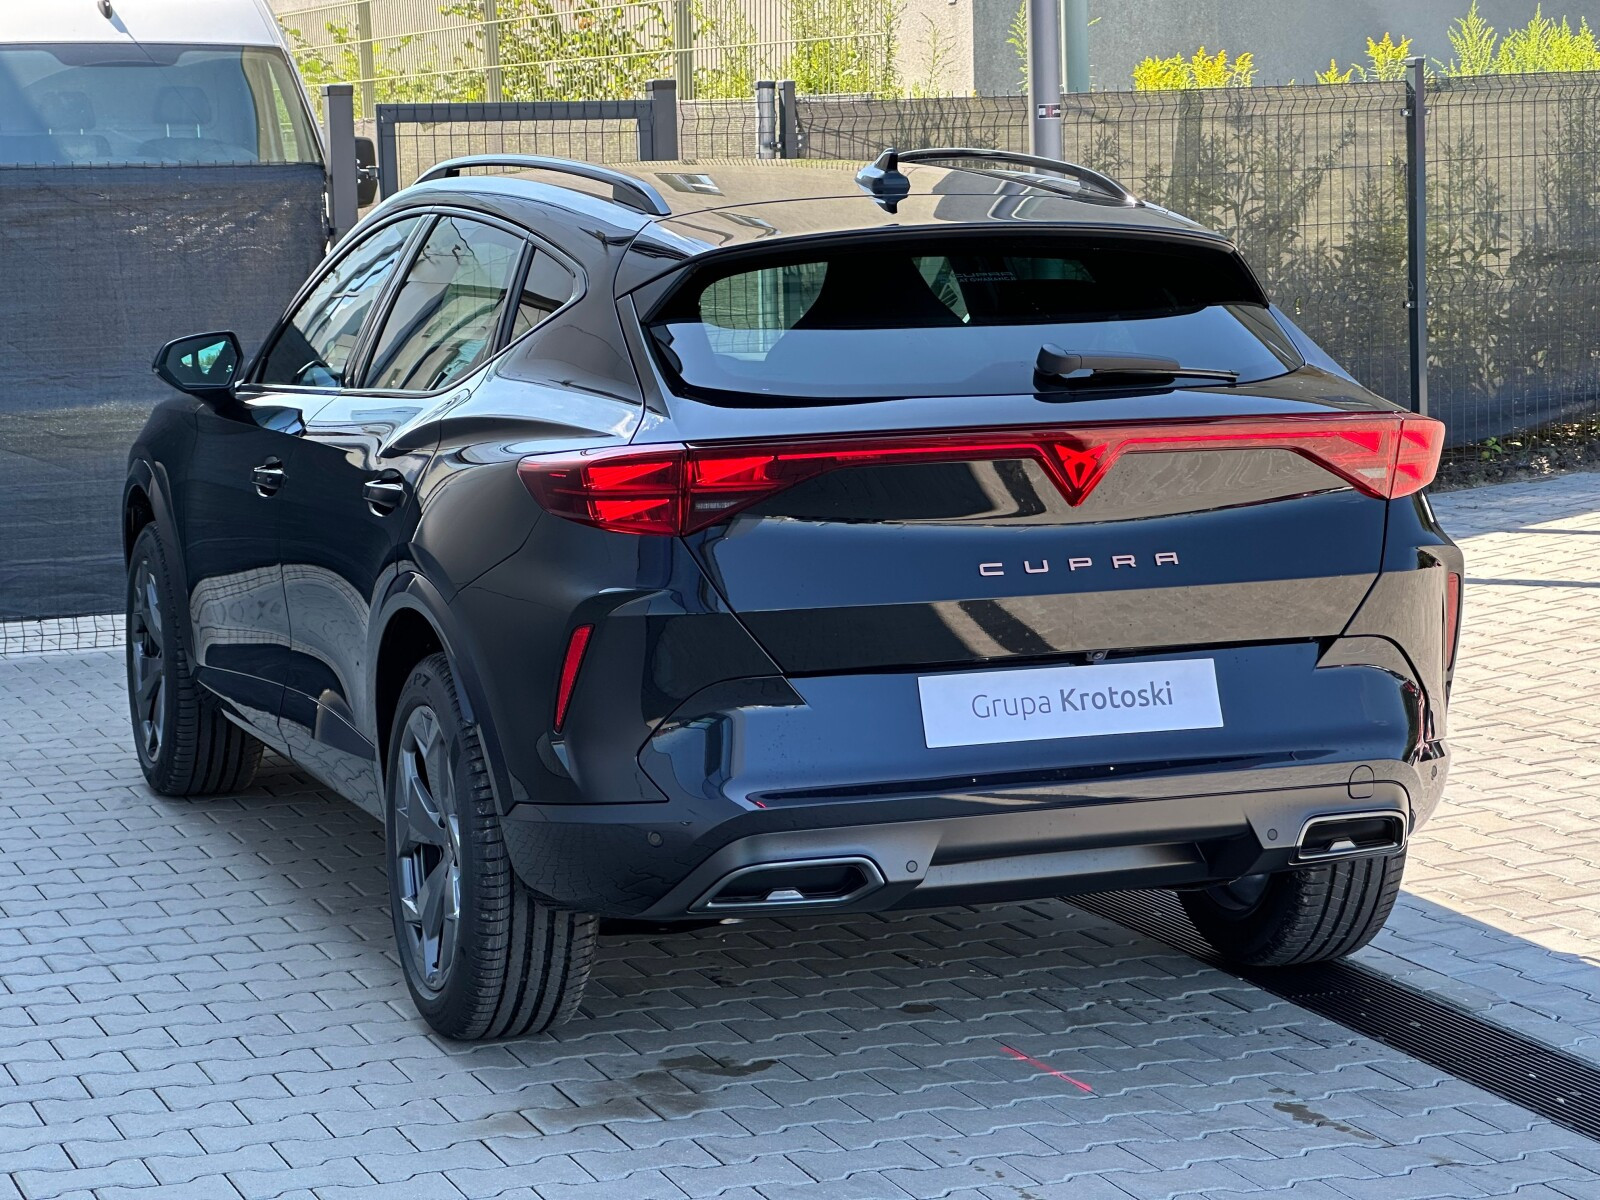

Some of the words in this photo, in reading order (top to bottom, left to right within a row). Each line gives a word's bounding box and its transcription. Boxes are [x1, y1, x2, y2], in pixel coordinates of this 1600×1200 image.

[978, 552, 1179, 577] CUPRA
[971, 694, 1051, 720] Grupa
[1059, 681, 1174, 712] Krotoski
